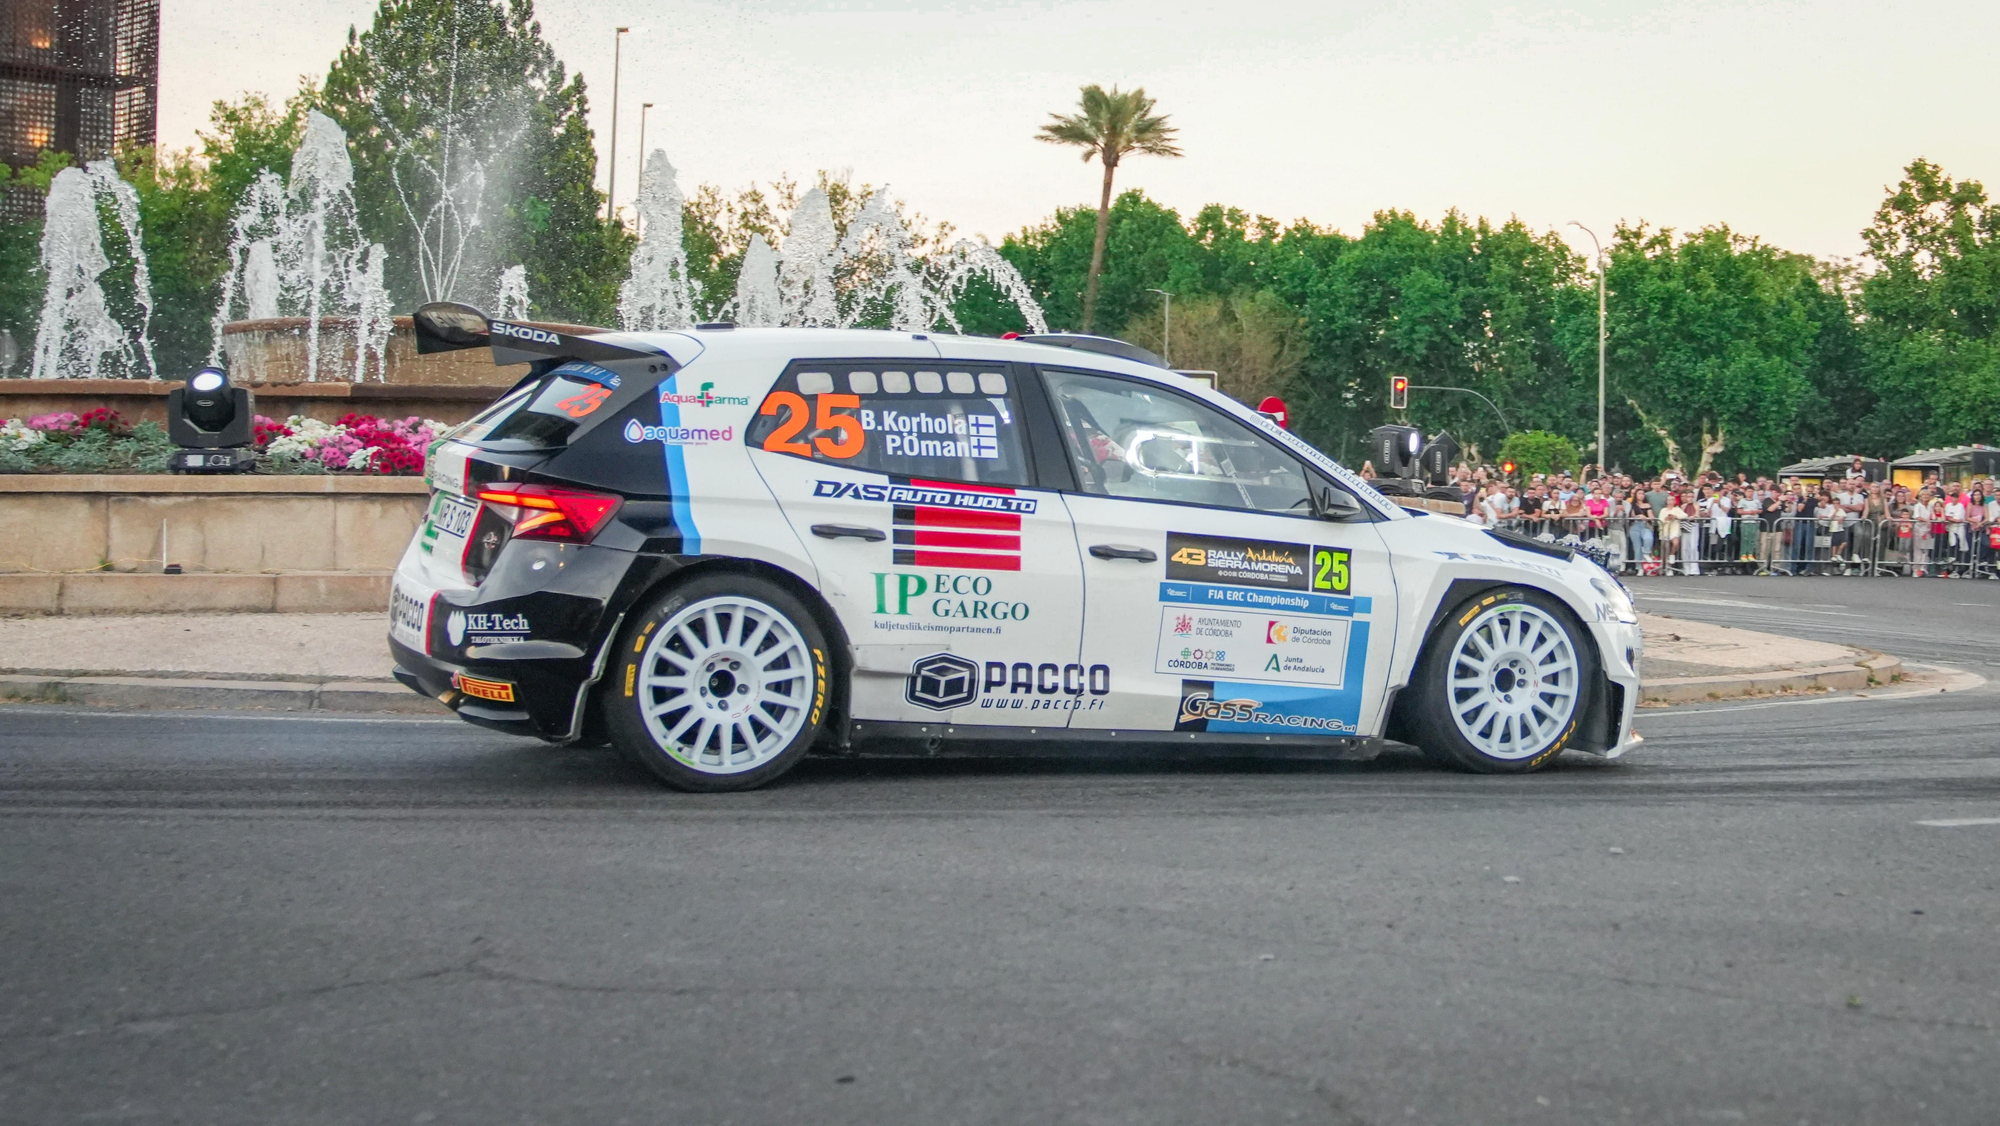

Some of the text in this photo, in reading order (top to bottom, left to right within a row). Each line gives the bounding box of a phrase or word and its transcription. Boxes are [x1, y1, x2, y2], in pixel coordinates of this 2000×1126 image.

[555, 383, 613, 417] 25
[760, 391, 865, 458] 25
[861, 410, 967, 434] B.Korhola
[645, 426, 732, 443] aquamed
[813, 480, 888, 501] DAS
[891, 489, 1036, 512] AUTO HUOLTO
[1171, 547, 1296, 565] 43 RALLY Andalucía
[1207, 558, 1303, 575] SIERRA MORENA
[1314, 551, 1349, 591] 25
[870, 572, 992, 616] IP ECO
[1208, 589, 1309, 608] FIA ERC Championship
[932, 598, 1030, 621] GARGO
[467, 613, 530, 630] KH-Tech
[874, 620, 1002, 635] kuljetusliikeismopartanen.fi
[1197, 617, 1242, 628] AYUNTAMIENTO
[1195, 627, 1233, 638] DE CÓRDOBA
[1291, 635, 1331, 645] de Córdoba
[1292, 626, 1332, 637] Diputación
[1167, 659, 1208, 670] CÓRDOBA
[1284, 656, 1303, 664] Junta
[1292, 664, 1325, 673] Andalucía
[983, 661, 1110, 695] PACCO
[461, 677, 511, 700] PIRELLI
[1253, 713, 1344, 731] RACING
